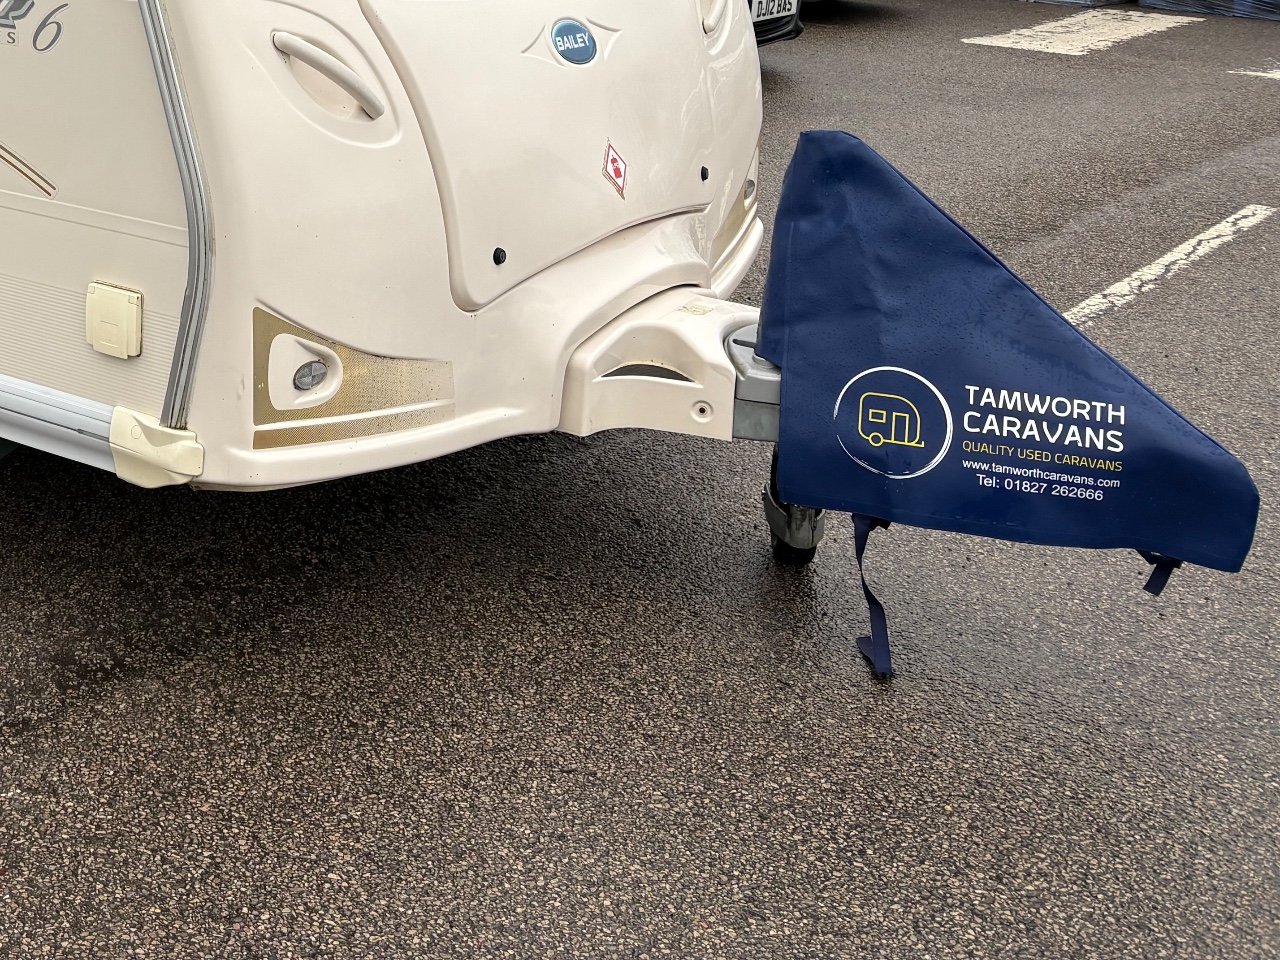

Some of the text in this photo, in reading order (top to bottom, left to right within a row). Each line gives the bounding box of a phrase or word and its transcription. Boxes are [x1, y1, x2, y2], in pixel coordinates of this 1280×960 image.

[32, 3, 70, 54] 6
[555, 32, 589, 51] BAILEY
[964, 384, 1126, 425] TAMWORTH
[963, 411, 1124, 453] CARAVANS
[962, 440, 1123, 472] QUALITY USED CARAVANS
[962, 459, 1121, 488] www.tamworthcaravans.com
[976, 473, 1104, 501] Tel: 01827 262666
